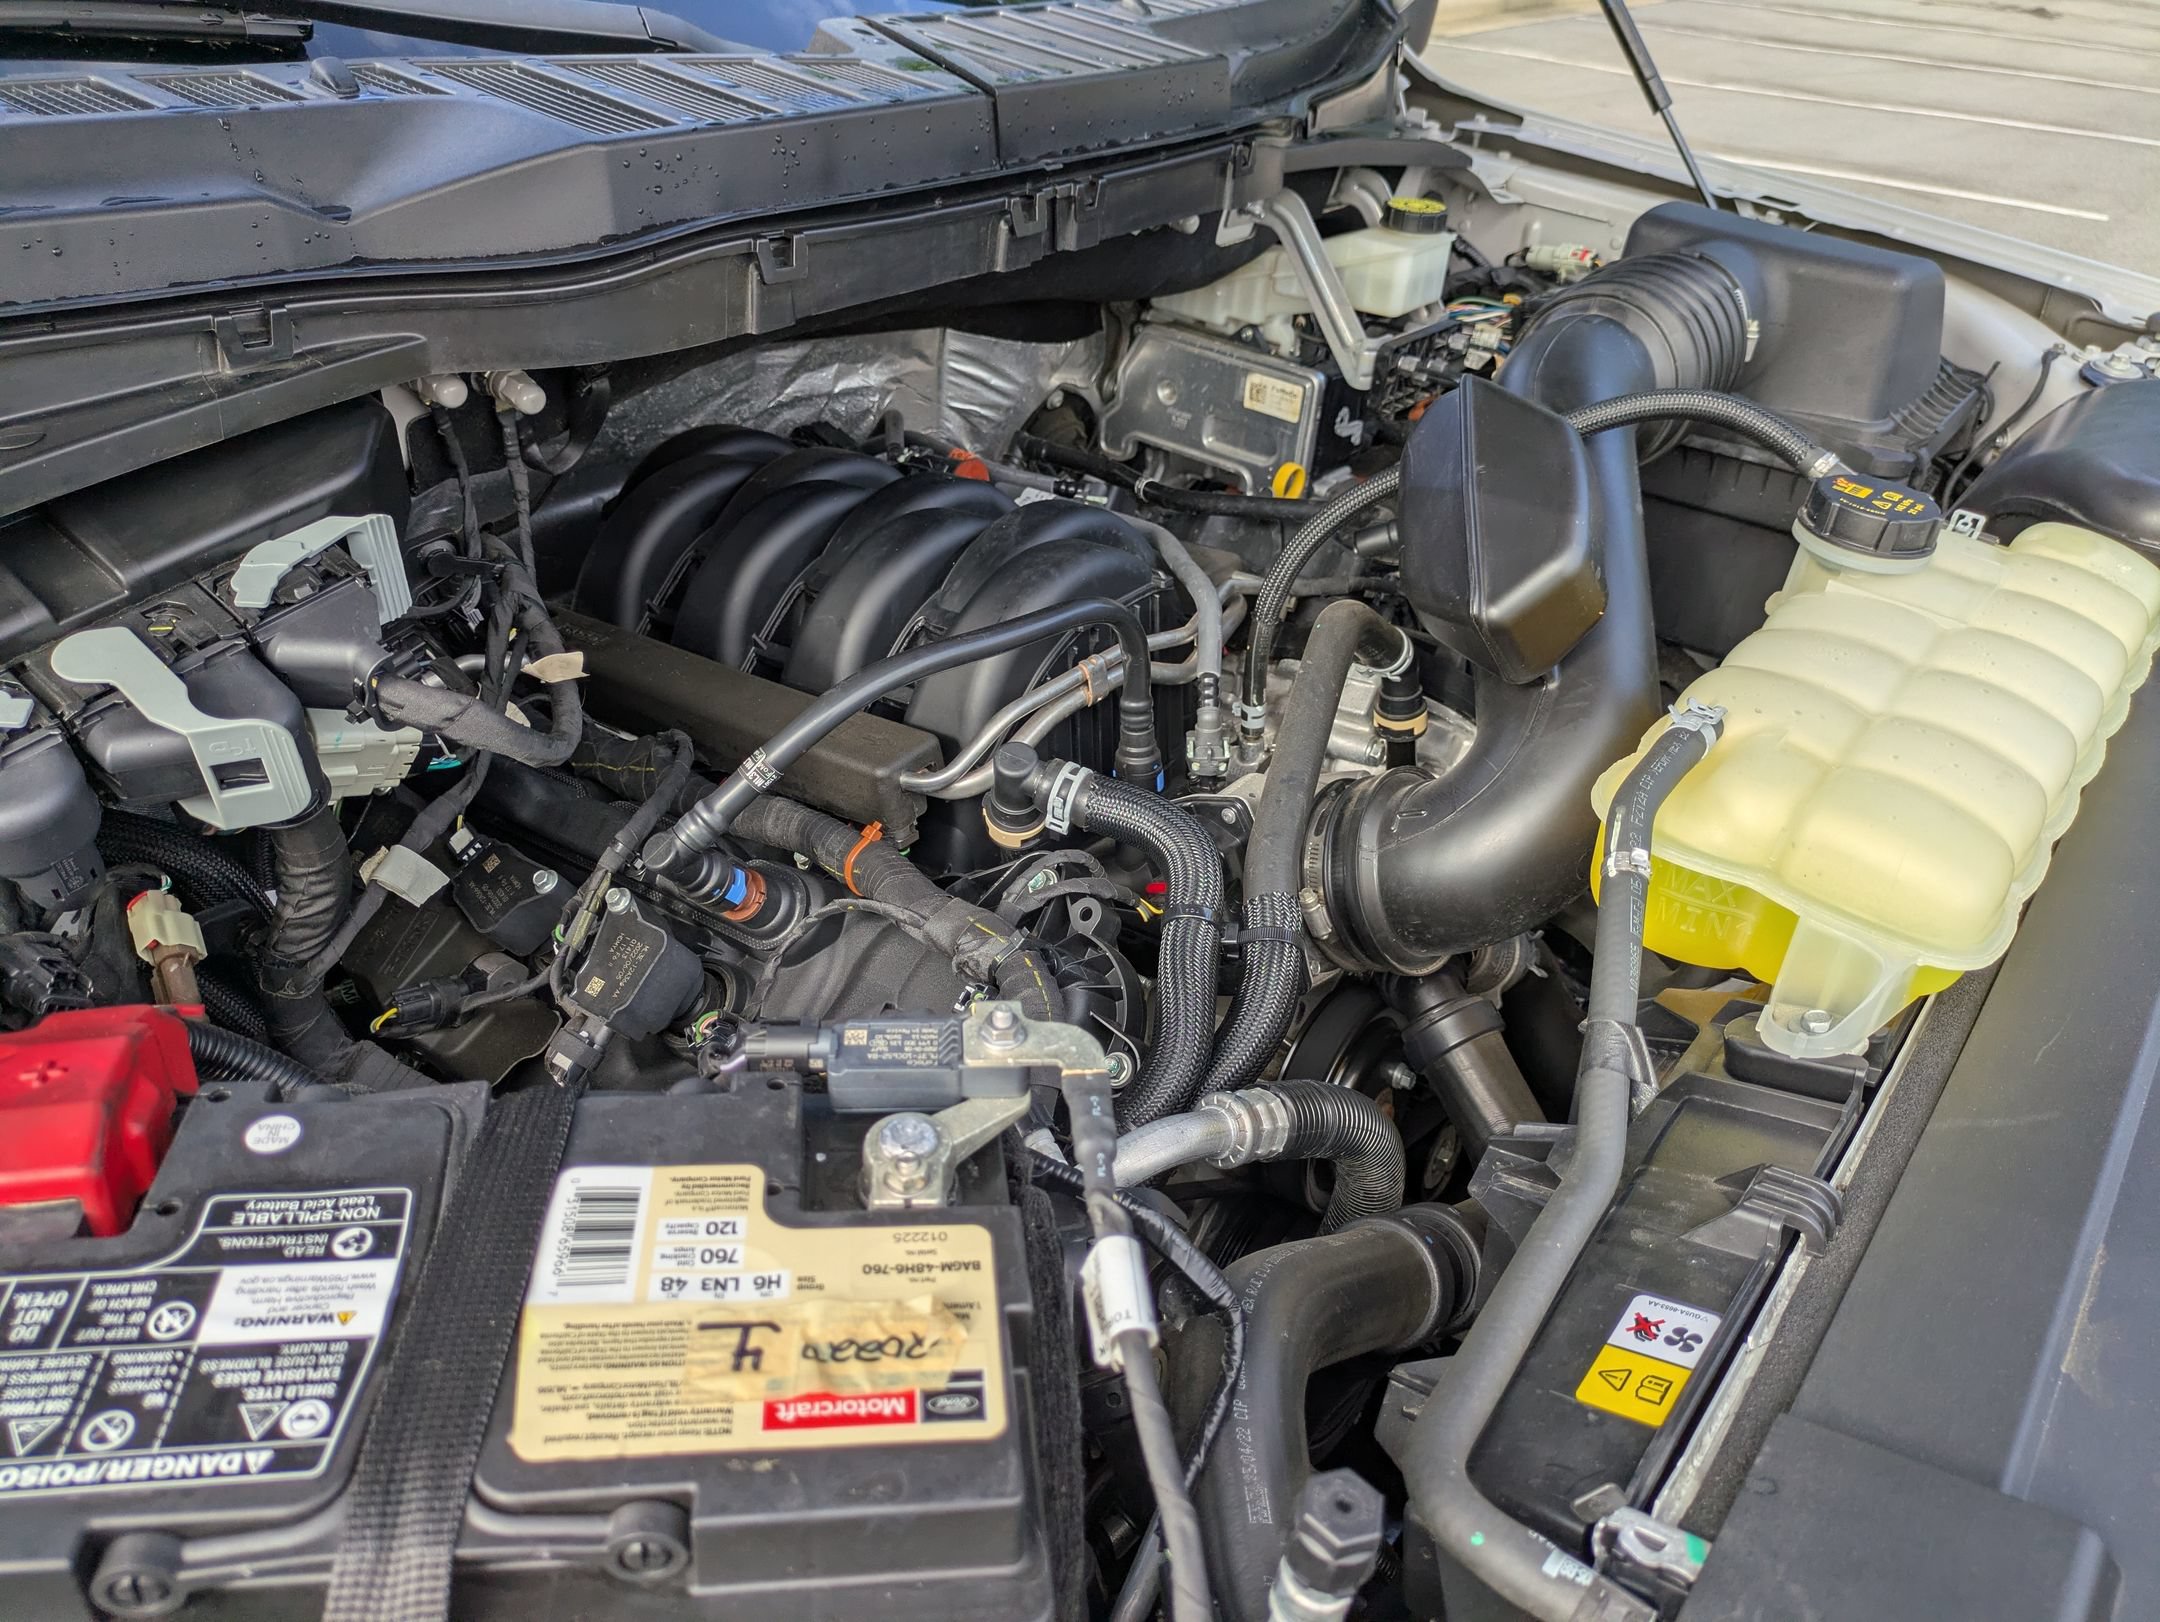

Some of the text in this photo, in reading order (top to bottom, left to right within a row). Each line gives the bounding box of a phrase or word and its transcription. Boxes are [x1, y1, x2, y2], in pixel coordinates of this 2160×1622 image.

[1663, 864, 1739, 907] MAX
[1654, 895, 1731, 940] MIN
[614, 941, 643, 980] 2022/06/05
[244, 1195, 375, 1212] Lead Acid Battery
[230, 1205, 381, 1227] NON-SPILLABLE
[665, 1222, 700, 1230] Capacity
[705, 1221, 738, 1236] 120
[217, 1232, 329, 1250] INSTRUCTIONS.
[892, 1231, 948, 1243] 012225
[282, 1245, 326, 1258] READ
[552, 1237, 570, 1276] 65966
[659, 1252, 696, 1261] Cranking
[700, 1248, 739, 1265] 760
[676, 1259, 696, 1267] Cold
[862, 1260, 982, 1275] BAGM-48H6-760
[311, 1283, 344, 1293] hands
[347, 1281, 377, 1291] Wash
[660, 1274, 782, 1292] H6 LN3 48
[796, 1275, 816, 1284] Size
[796, 1283, 825, 1291] Group
[284, 1284, 308, 1295] after
[284, 1292, 355, 1304] Reproductive
[12, 1290, 69, 1310] OPEN.
[85, 1296, 152, 1313] REACH OF
[266, 1302, 330, 1315] Cancer and
[9, 1308, 54, 1326] NOT
[97, 1310, 146, 1326] OF THE
[233, 1311, 335, 1328] WARNING:
[8, 1324, 40, 1343] DO
[73, 1325, 141, 1342] KEEP OUT
[329, 1340, 349, 1354] OR
[38, 1354, 93, 1370] SEVERE
[109, 1349, 175, 1366] SMOKING
[198, 1353, 346, 1375] CAN CAUSE BLINDNESS
[112, 1363, 169, 1379] FLAMES
[211, 1366, 342, 1389] EXPLOSIVE GASES
[48, 1382, 80, 1398] CAN
[106, 1378, 164, 1395] SPARKS
[285, 1382, 338, 1400] SHIELD
[141, 1391, 168, 1409] NO
[689, 1406, 734, 1417] Warranty
[773, 1396, 907, 1422] Motorcraft
